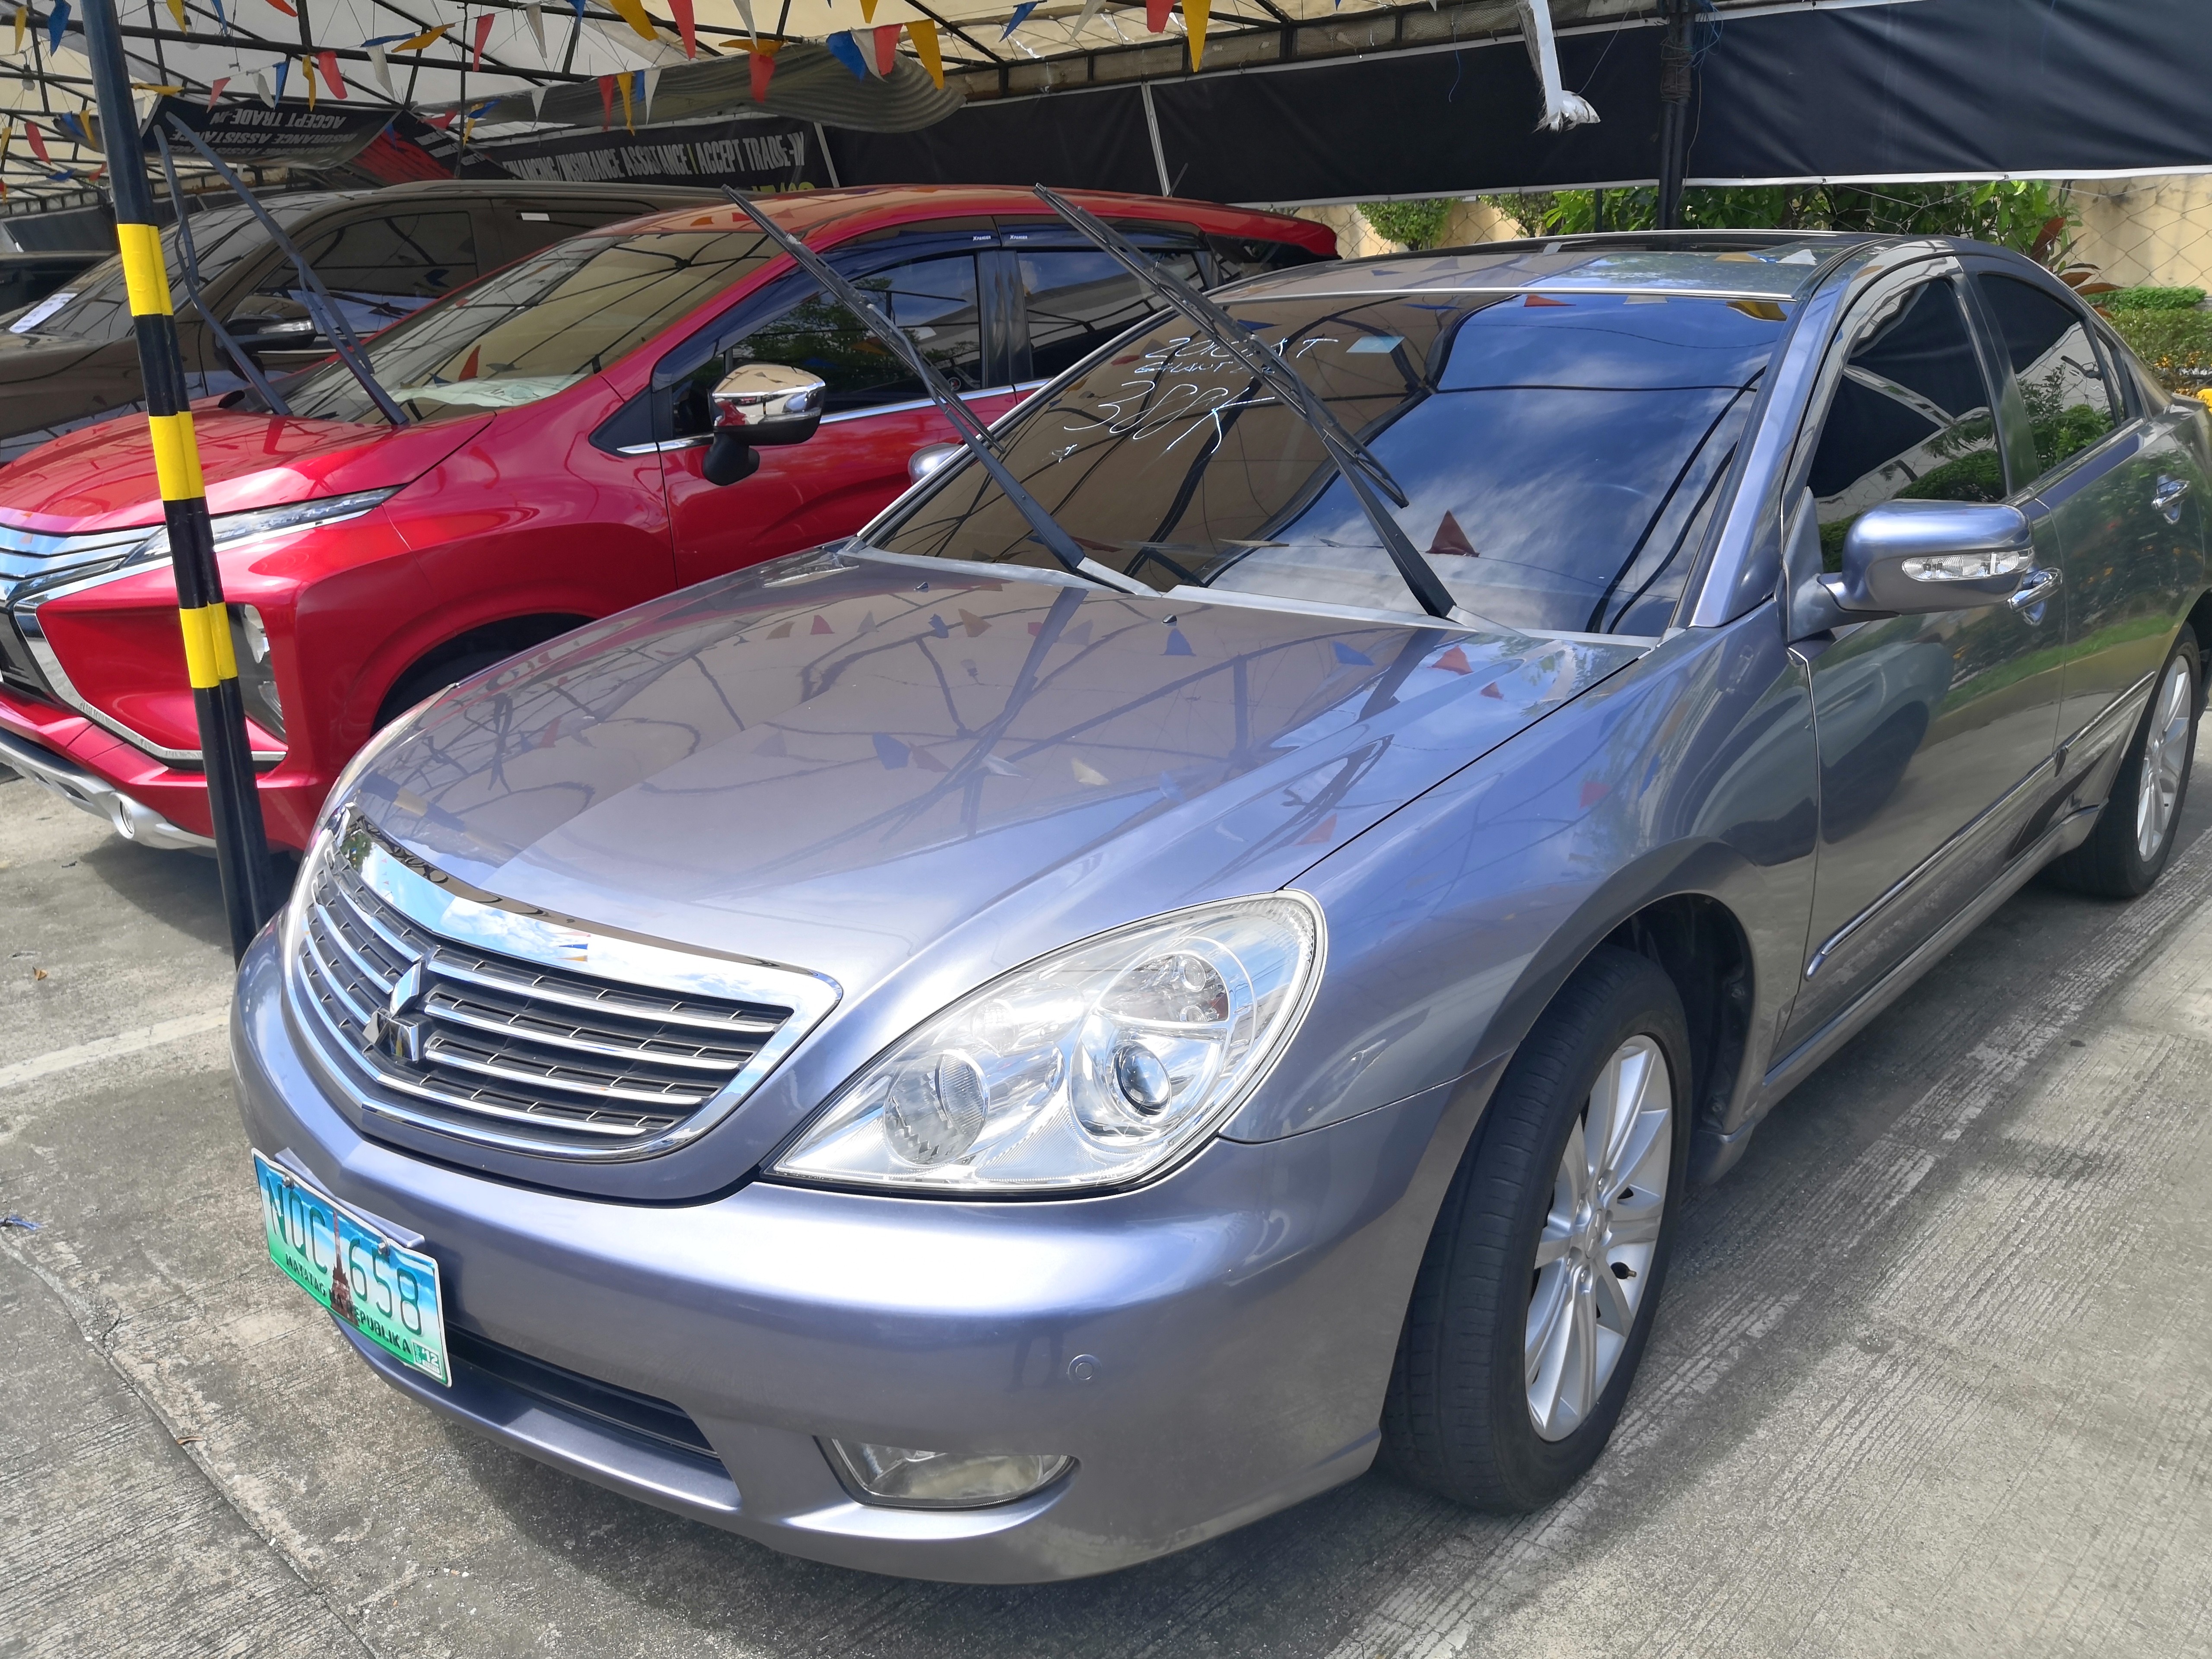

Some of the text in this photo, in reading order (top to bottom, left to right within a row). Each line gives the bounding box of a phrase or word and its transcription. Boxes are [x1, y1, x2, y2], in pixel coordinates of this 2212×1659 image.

[285, 112, 347, 129] ACCEPT
[271, 133, 358, 144] INSURANCE
[620, 143, 693, 177] ASSISTANCE
[695, 138, 745, 175] ACCEPT
[348, 1238, 423, 1336] 658
